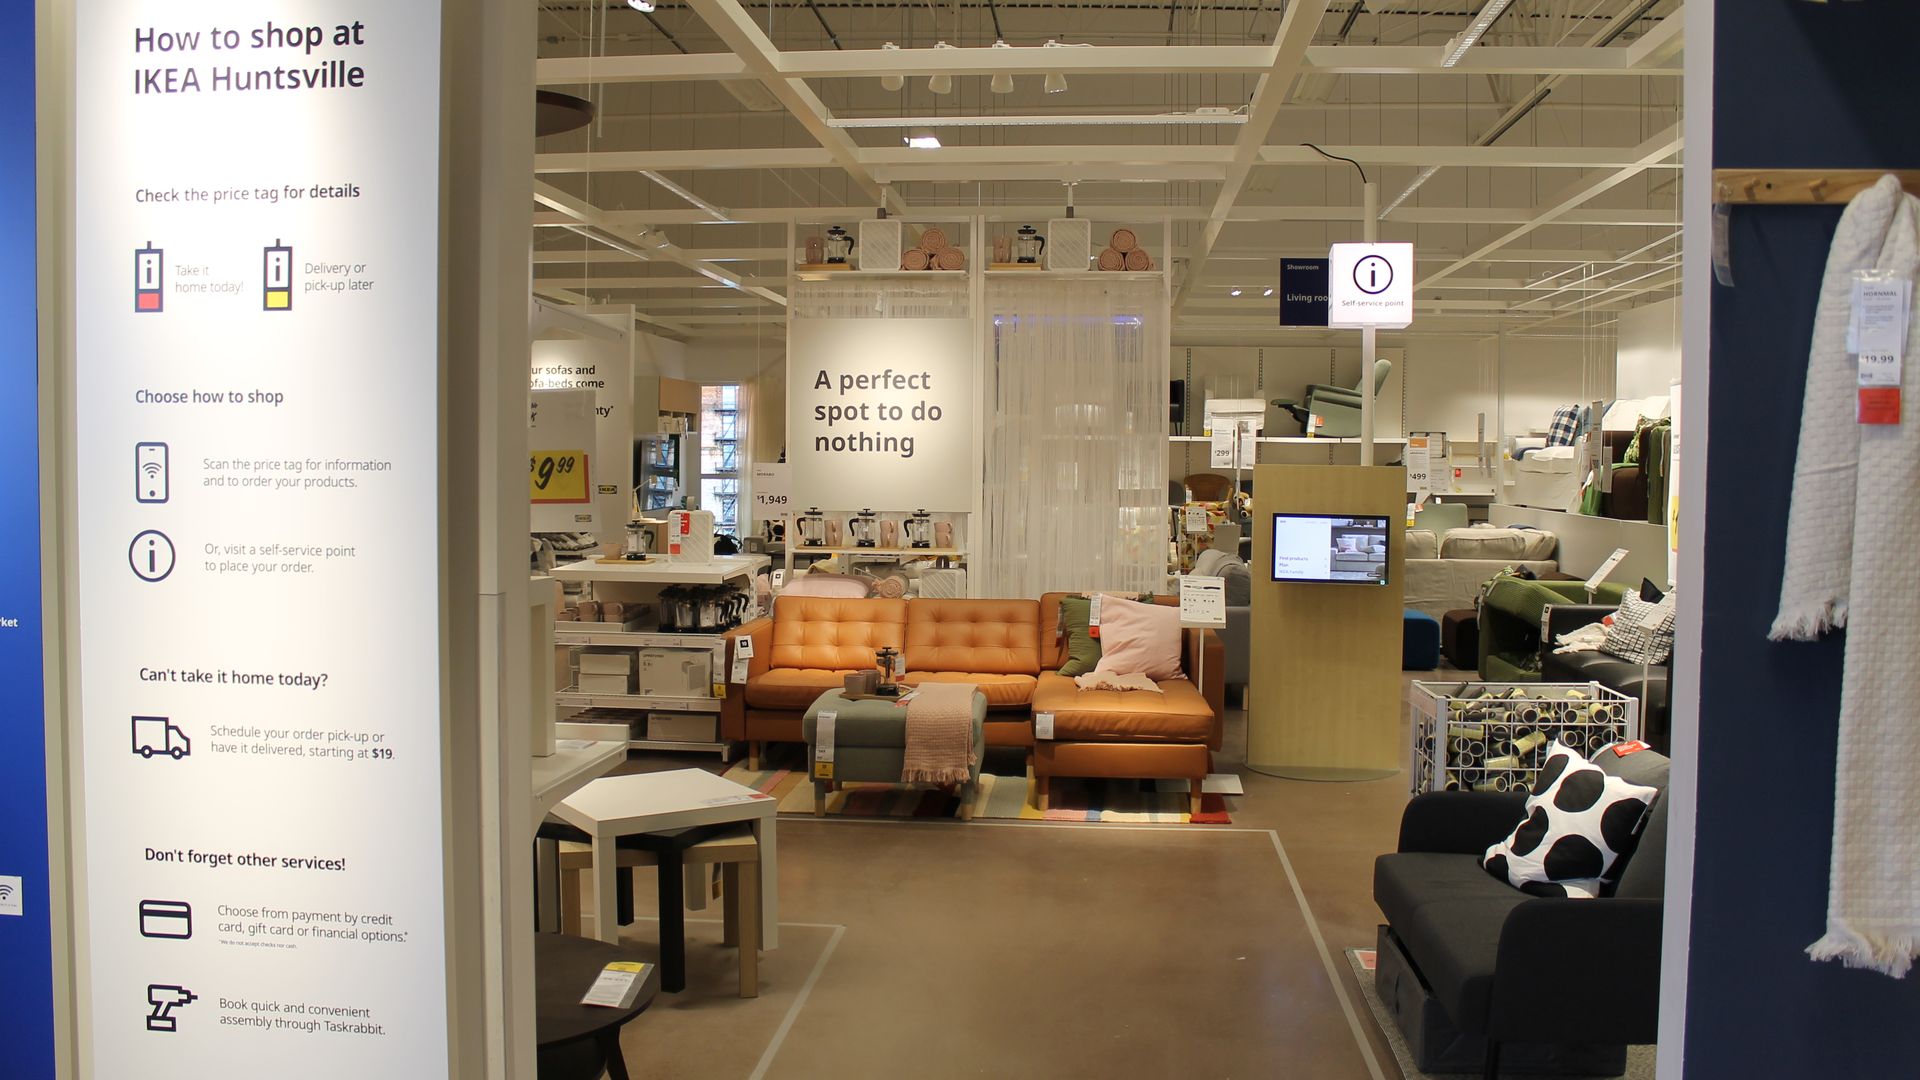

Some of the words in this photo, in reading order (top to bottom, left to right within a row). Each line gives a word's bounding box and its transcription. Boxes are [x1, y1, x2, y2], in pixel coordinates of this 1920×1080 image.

[136, 28, 200, 53] How
[211, 27, 240, 50] to
[251, 22, 323, 55] shop
[333, 21, 364, 46] at
[135, 68, 200, 94] IKEA
[213, 60, 364, 91] Huntsville
[136, 188, 179, 202] Check
[184, 188, 208, 201] the
[214, 187, 249, 204] price
[254, 188, 278, 203] tag
[284, 185, 305, 199] for
[310, 184, 360, 198] details
[175, 265, 200, 276] Take
[203, 265, 209, 276] it
[305, 262, 352, 277] Delivery
[353, 264, 366, 274] or
[176, 282, 207, 293] home
[210, 280, 243, 295] today!
[305, 279, 345, 294] pick-up
[349, 278, 374, 290] later
[1287, 293, 1312, 303] Living
[1385, 300, 1404, 308] point
[1861, 355, 1895, 364] 19.99
[531, 367, 543, 375] ur
[545, 365, 573, 375] sofas
[575, 365, 596, 375] and
[530, 379, 573, 388] ofa-beds
[575, 380, 605, 388] come
[814, 370, 832, 389] A
[839, 369, 931, 395] perfect
[136, 389, 188, 403] Choose
[193, 389, 224, 403] how
[228, 391, 243, 403] to
[248, 389, 283, 407] shop
[814, 402, 870, 426] spot
[877, 402, 903, 421] to
[911, 400, 942, 421] do
[815, 431, 914, 458] nothing
[203, 458, 229, 470] Scan
[232, 458, 250, 470] the
[254, 459, 280, 473] price
[284, 460, 302, 473] tag
[305, 458, 322, 470] for
[325, 459, 391, 472] information
[203, 475, 224, 486] and
[227, 477, 239, 486] to
[242, 475, 272, 487] order
[275, 478, 301, 490] your
[304, 475, 357, 490] products.
[205, 543, 220, 555] Or,
[224, 544, 246, 555] visit
[249, 547, 256, 555] a
[259, 544, 322, 556] self-service
[326, 545, 355, 560] point
[205, 561, 216, 571] to
[220, 560, 248, 574] place
[252, 563, 278, 575] your
[281, 561, 314, 573] order.
[0, 617, 18, 627] ket
[140, 668, 176, 682] Can't
[181, 669, 213, 683] take
[218, 670, 227, 683] it
[232, 670, 274, 685] home
[278, 672, 328, 690] today?
[211, 725, 261, 738] Schedule
[264, 729, 290, 741] your
[293, 728, 324, 740] order
[328, 730, 369, 744] pick-up
[371, 734, 385, 743] or
[211, 741, 237, 753] have
[241, 742, 248, 754] it
[251, 743, 305, 757] delivered,
[309, 745, 354, 761] starting
[357, 748, 370, 759] at
[145, 848, 184, 862] Don't
[188, 849, 233, 868] forget
[237, 853, 277, 867] other
[282, 856, 345, 871] services!
[218, 905, 259, 919] Choose
[261, 907, 288, 919] from
[290, 912, 342, 926] payment
[344, 912, 359, 926] by
[360, 914, 393, 926] credit
[218, 921, 245, 935] card,
[248, 922, 267, 936] gift
[270, 924, 294, 935] card
[297, 927, 309, 936] or
[312, 926, 359, 940] financial
[220, 998, 249, 1012] Book
[249, 1001, 282, 1015] quick
[282, 1003, 305, 1014] and
[307, 1006, 370, 1019] convenient
[220, 1013, 273, 1030] assembly
[274, 1016, 322, 1033] through
[323, 1020, 385, 1035] Taskrabbit.
